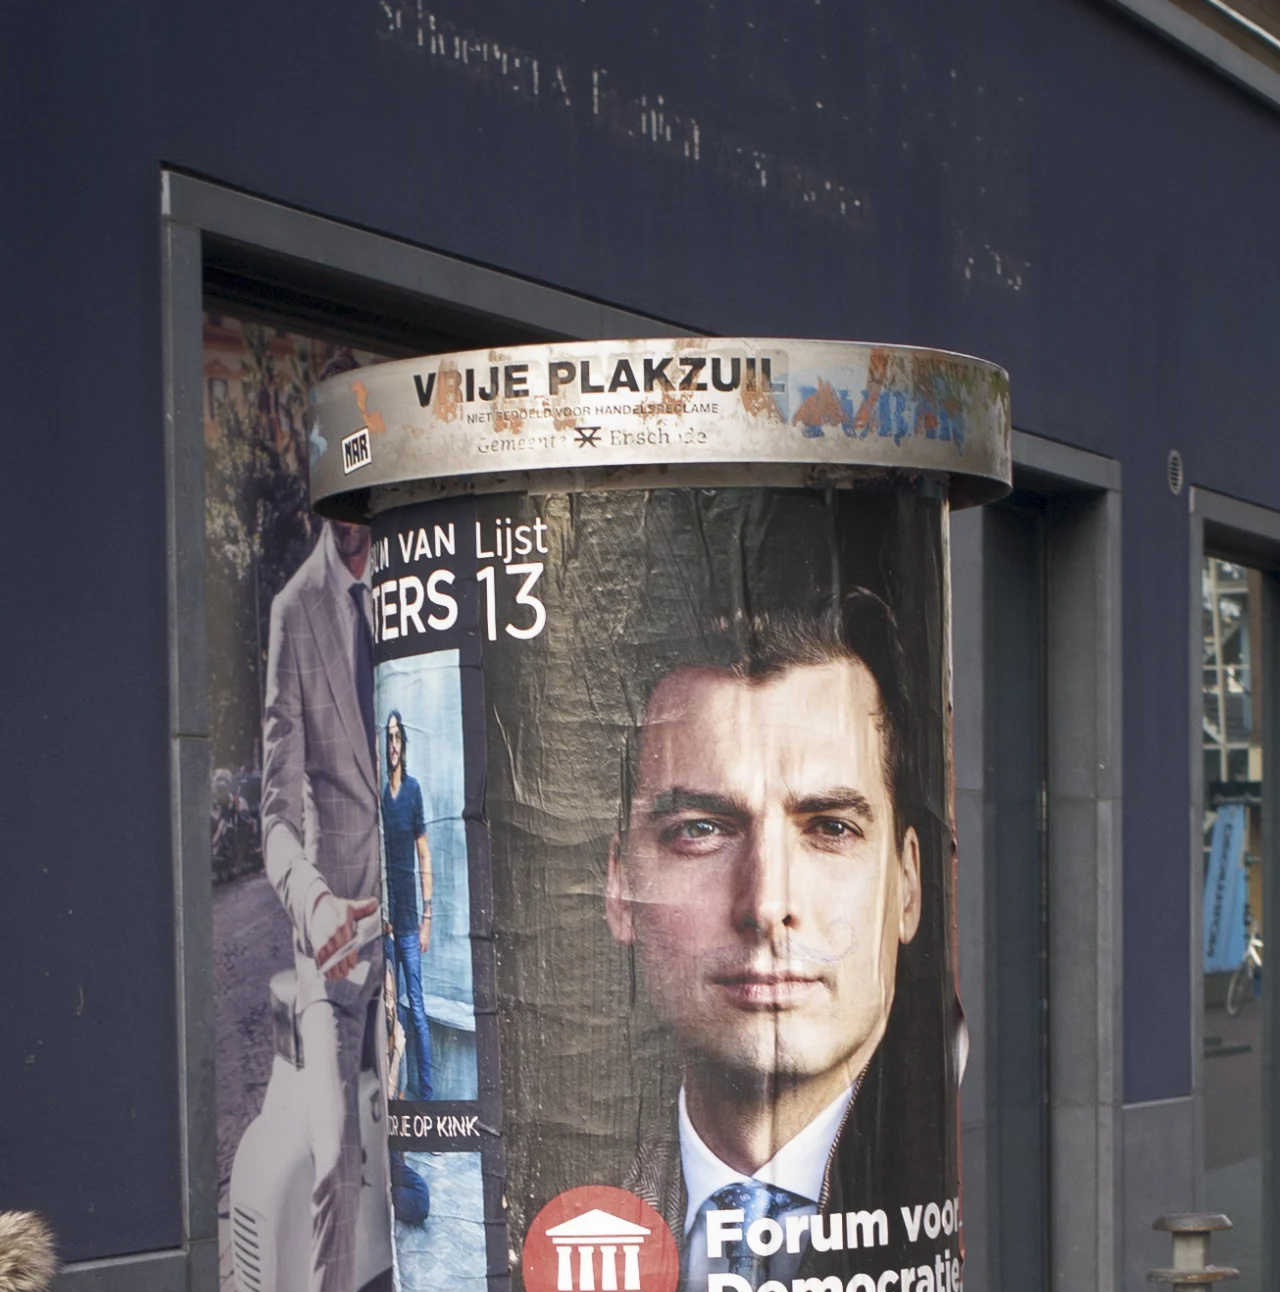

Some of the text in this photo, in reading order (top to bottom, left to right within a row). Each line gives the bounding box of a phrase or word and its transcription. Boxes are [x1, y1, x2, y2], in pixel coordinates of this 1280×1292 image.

[549, 357, 786, 396] PLAKZUIL
[467, 414, 492, 424] NIET
[477, 428, 707, 454] Gemeent Enschde
[398, 523, 456, 563] VAN
[475, 517, 549, 563] Lijst
[477, 563, 547, 641] 13
[413, 1115, 433, 1138] OP
[436, 1115, 480, 1138] KINK
[706, 1196, 960, 1259] Forum voor
